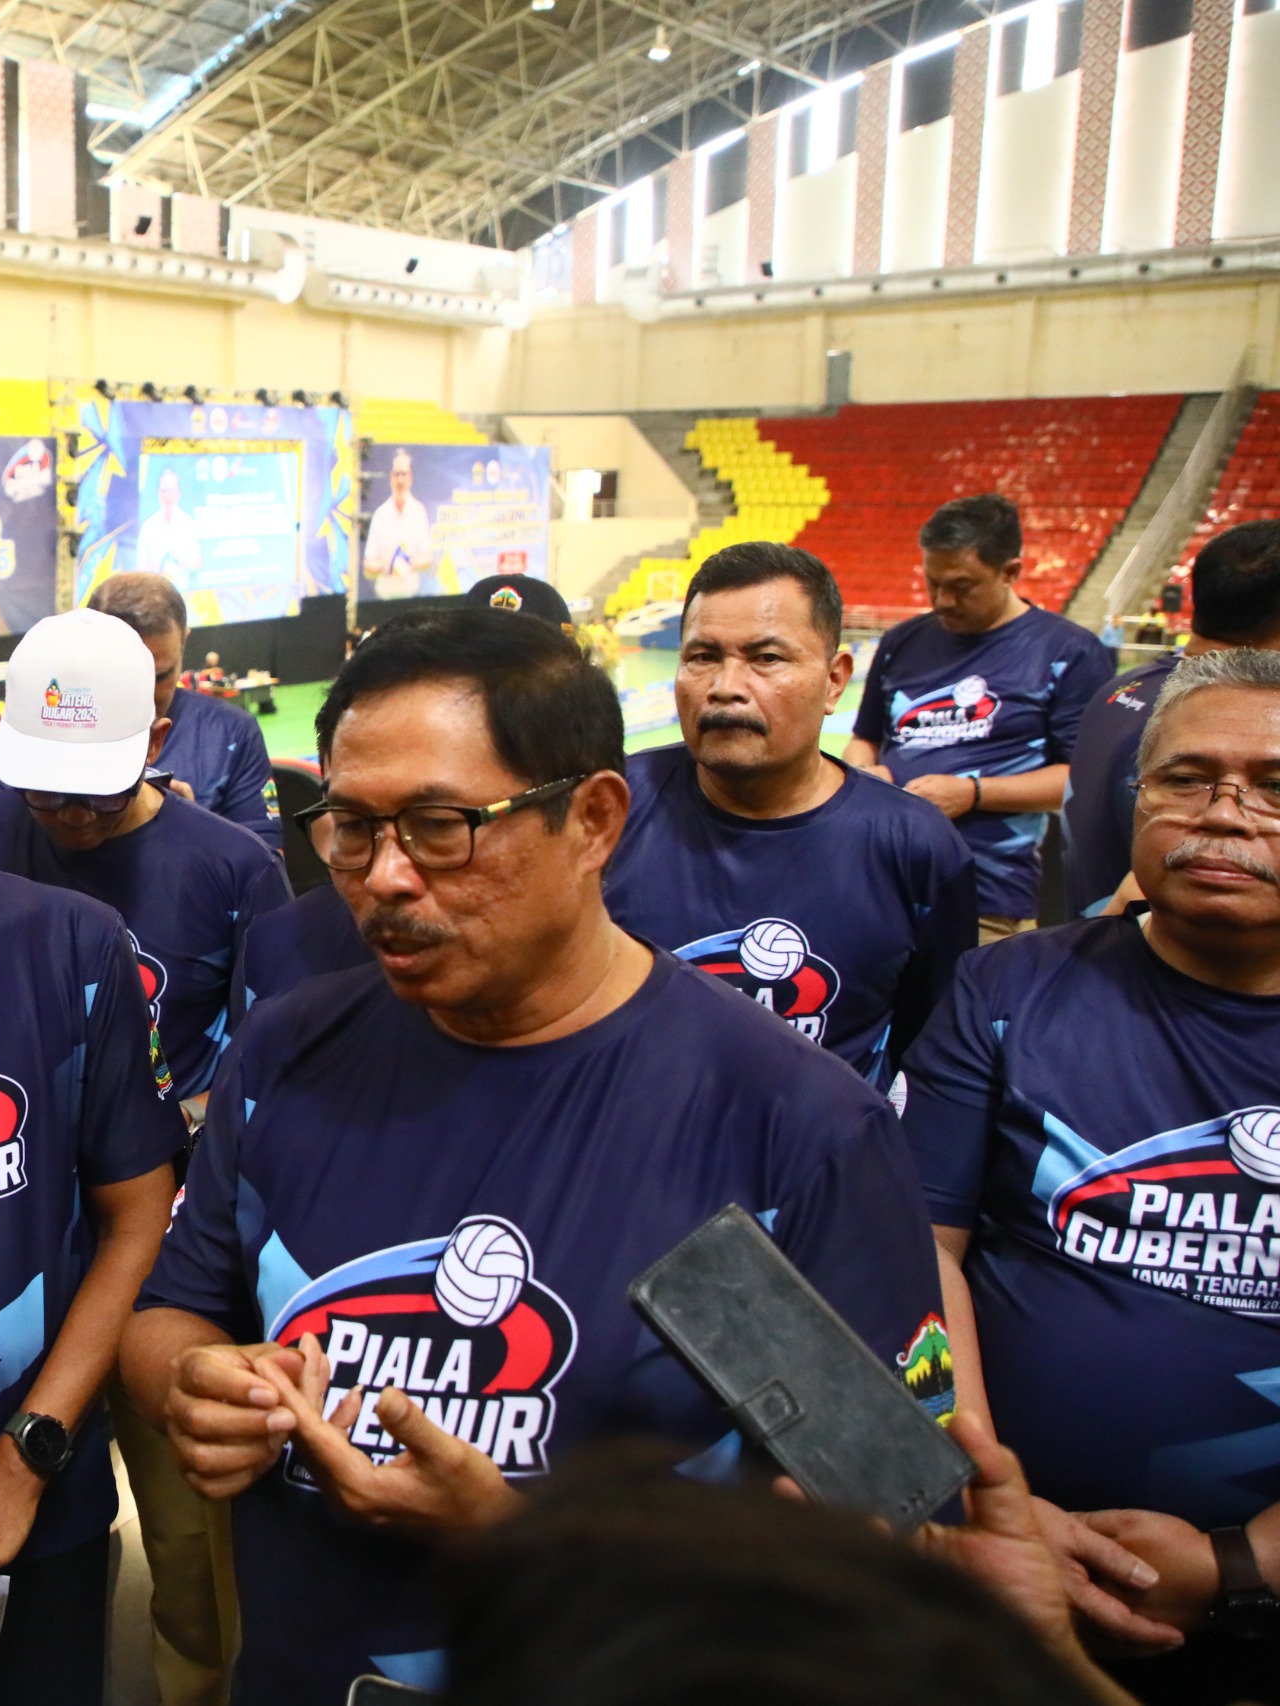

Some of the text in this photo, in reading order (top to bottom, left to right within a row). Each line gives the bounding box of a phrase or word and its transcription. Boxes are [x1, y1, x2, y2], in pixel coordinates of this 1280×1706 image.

[59, 694, 93, 708] JATENG
[74, 709, 98, 721] 2024
[1129, 1183, 1280, 1234] PIALA
[1203, 1295, 1260, 1310] FEBRUARI
[327, 1318, 472, 1393] PIALA
